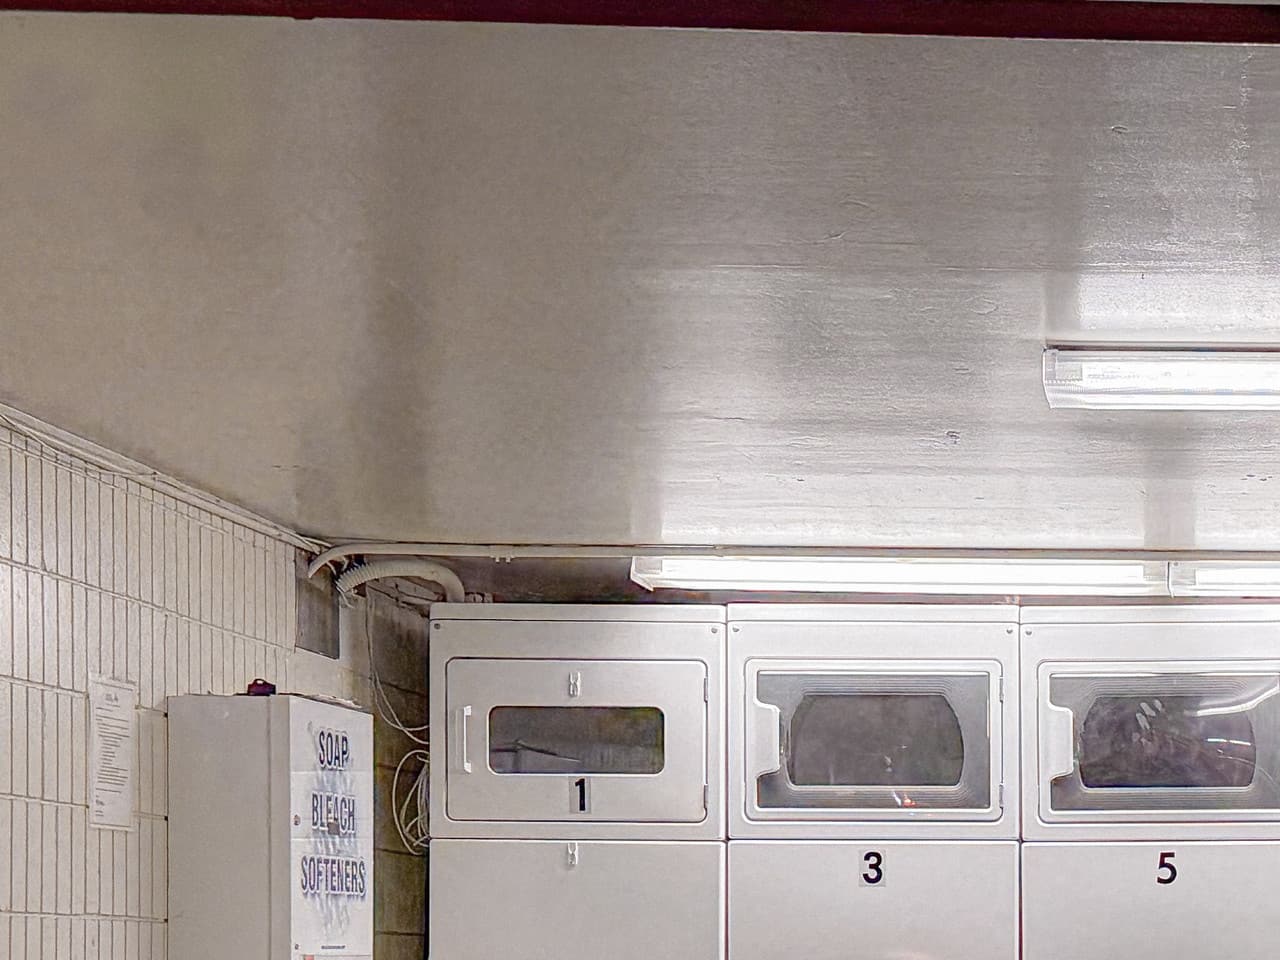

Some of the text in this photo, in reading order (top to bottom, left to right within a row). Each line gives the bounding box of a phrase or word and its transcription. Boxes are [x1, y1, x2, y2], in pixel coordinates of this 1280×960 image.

[319, 730, 349, 766] SOAP
[312, 793, 355, 832] BLEACH
[575, 778, 587, 812] 1
[301, 855, 366, 894] SOFTENERS
[862, 851, 883, 884] 3
[1156, 852, 1177, 884] 5
